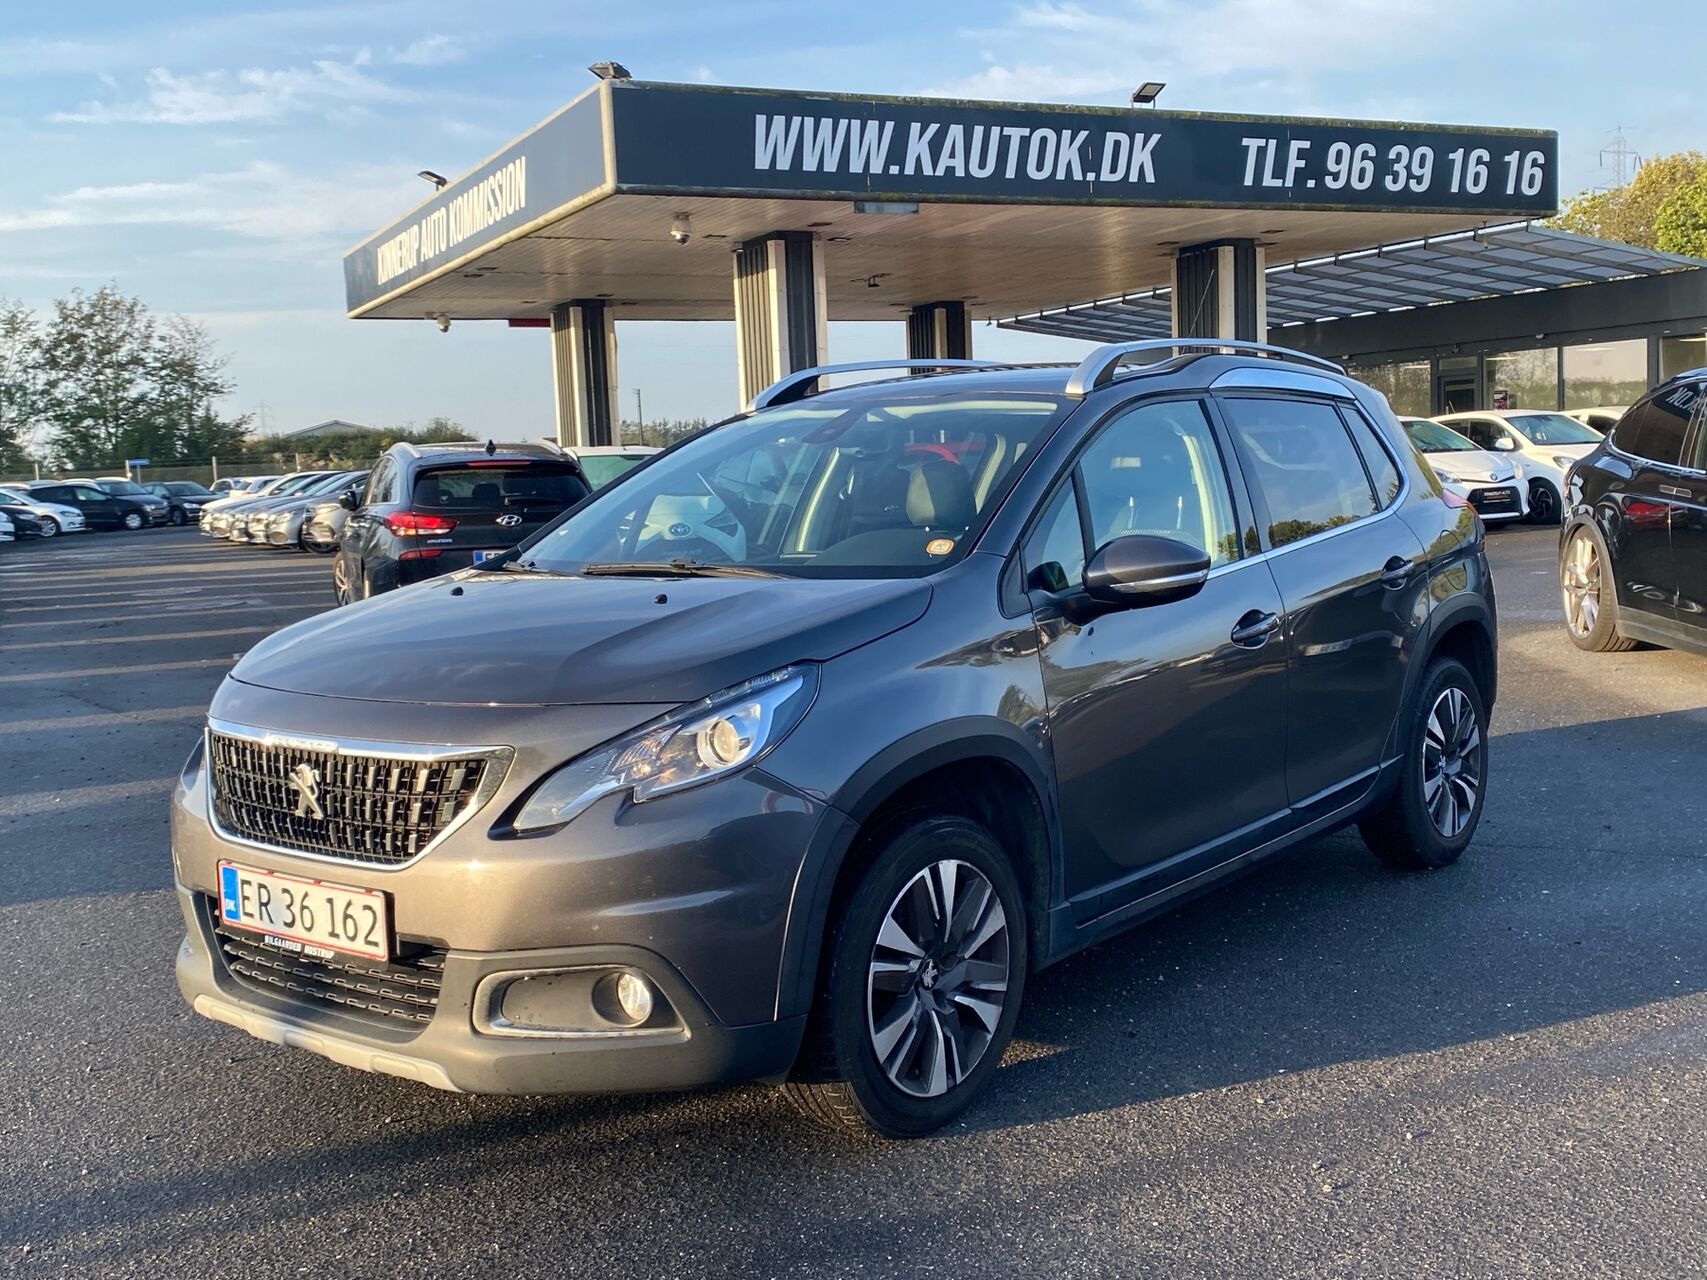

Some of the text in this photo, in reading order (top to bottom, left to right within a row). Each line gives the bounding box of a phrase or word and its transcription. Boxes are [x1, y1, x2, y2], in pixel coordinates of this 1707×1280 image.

[754, 114, 1162, 184] WWW.KAUTOK.DK
[1241, 137, 1545, 196] TLF. 96 39 16 16
[377, 156, 526, 286] KINNERUP AUTO KOMMISSION
[225, 898, 236, 912] DK
[240, 878, 380, 947] ER 36 162
